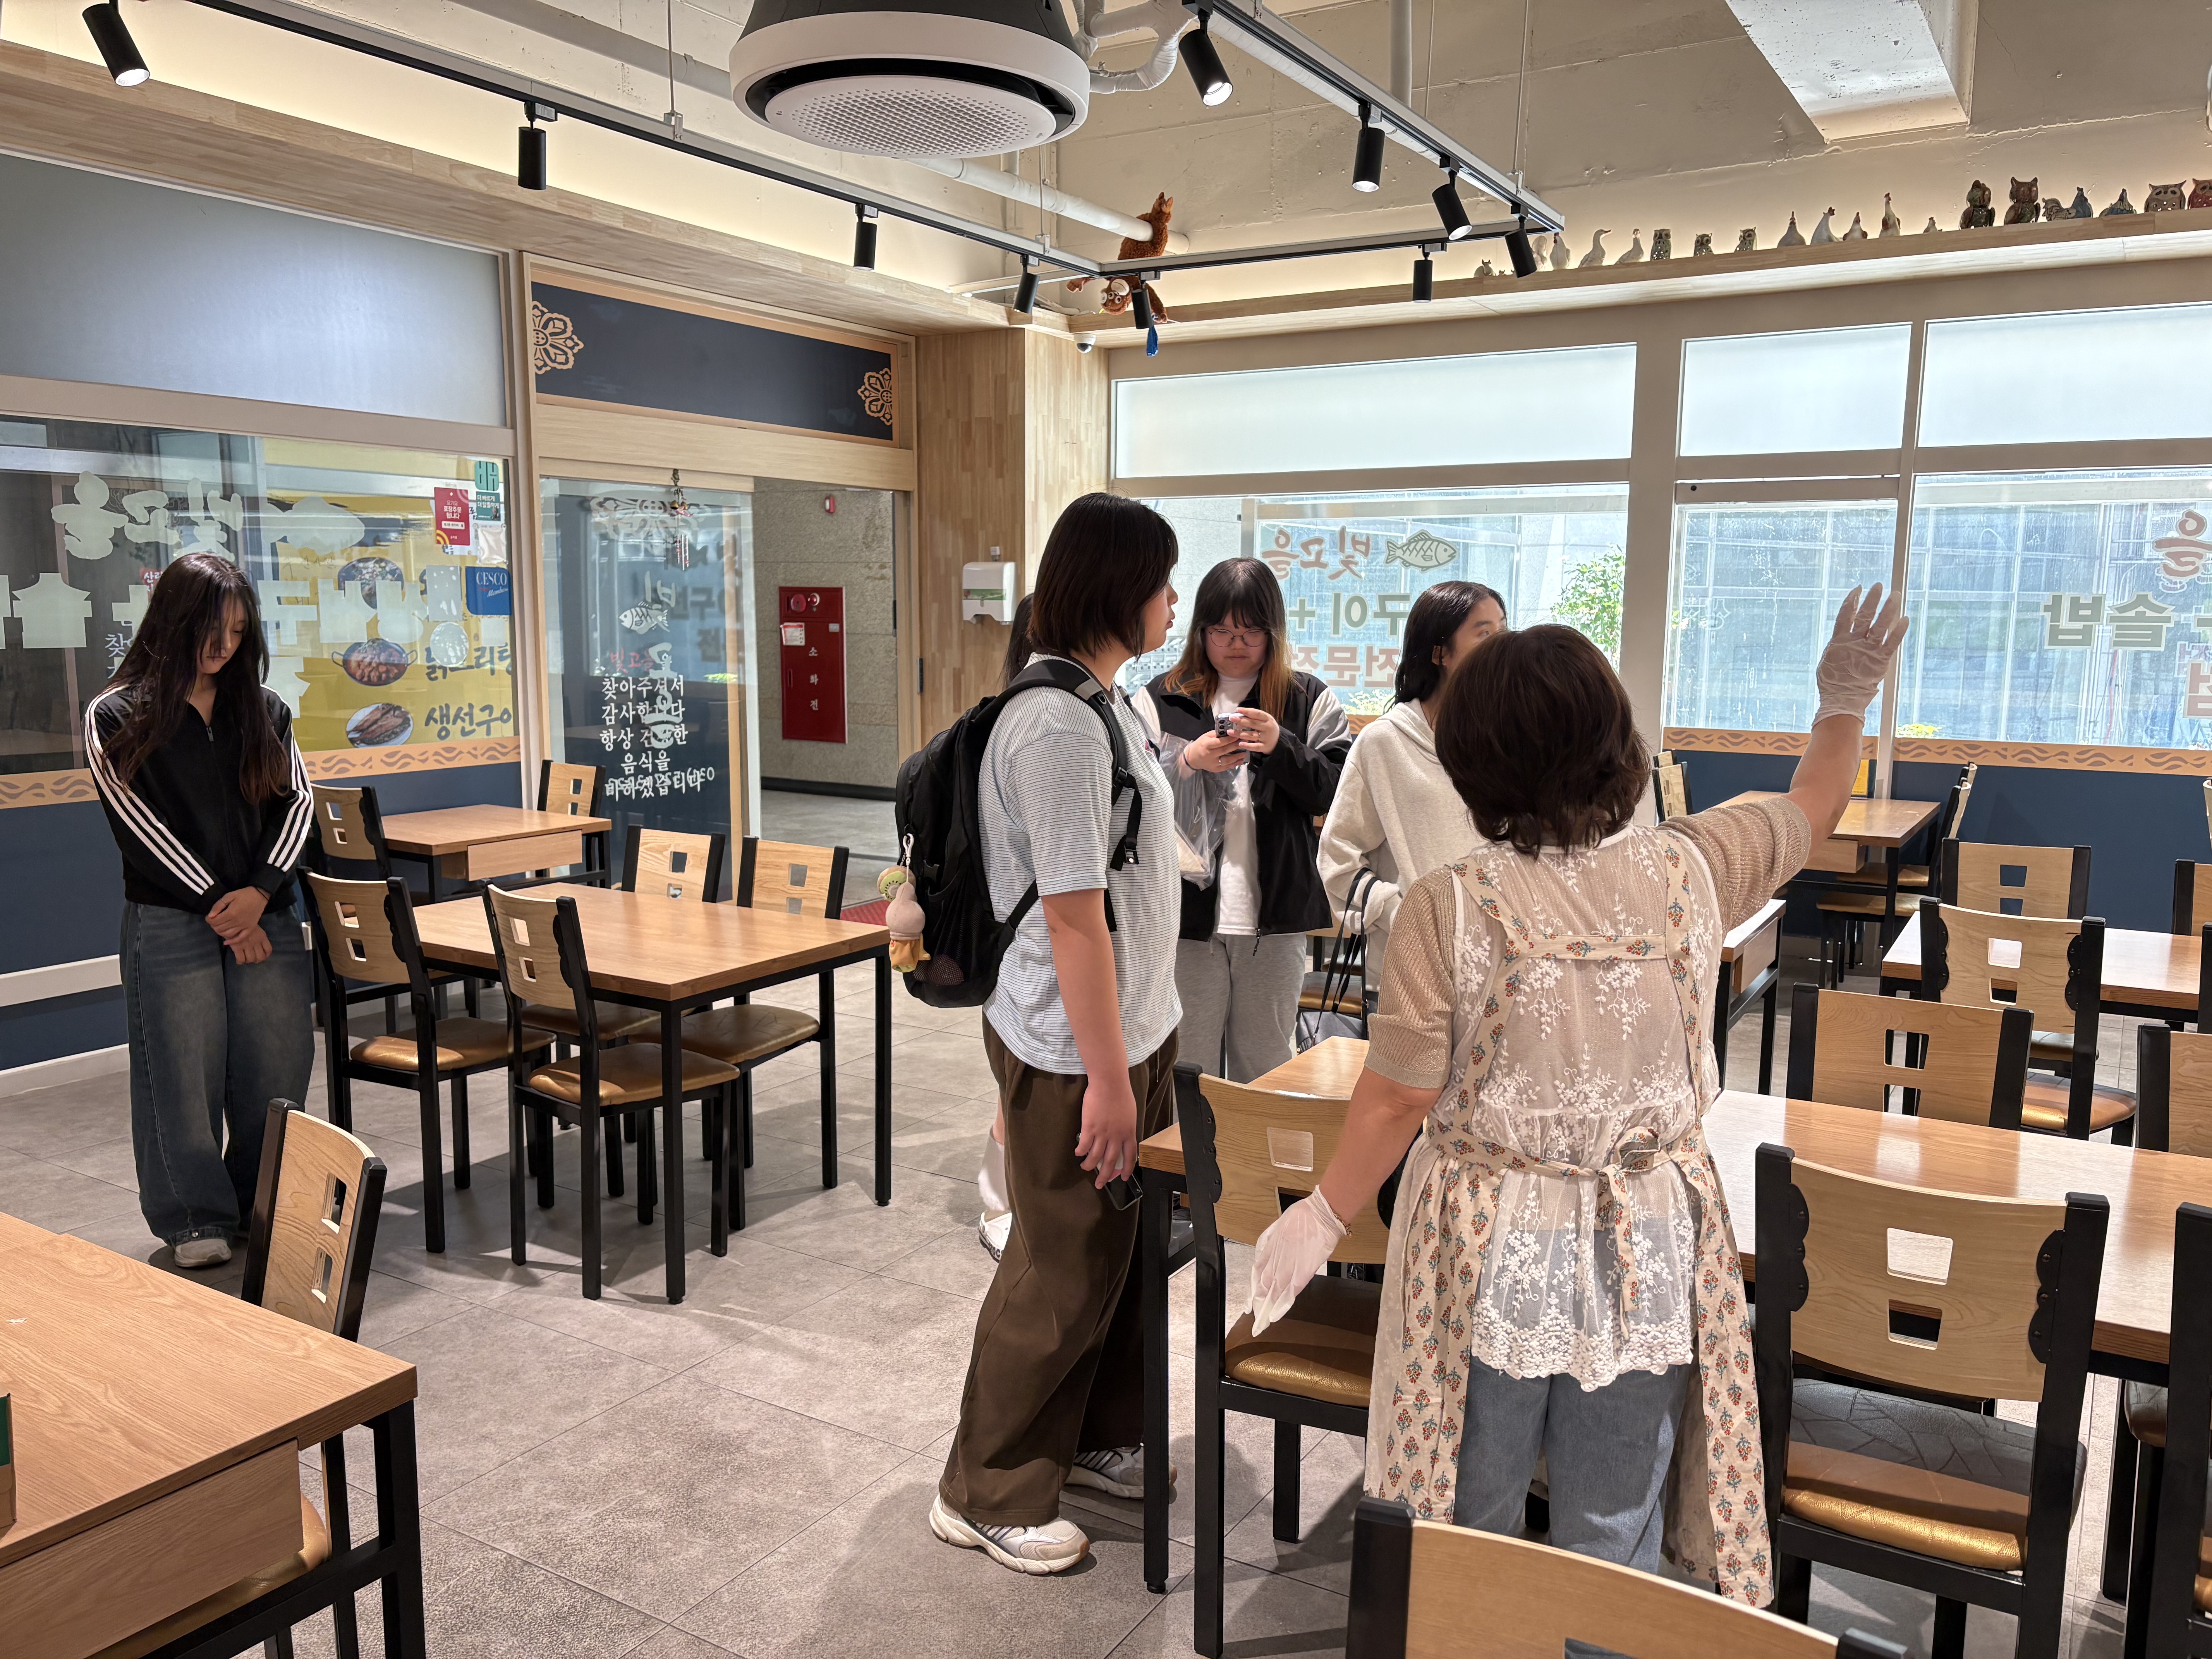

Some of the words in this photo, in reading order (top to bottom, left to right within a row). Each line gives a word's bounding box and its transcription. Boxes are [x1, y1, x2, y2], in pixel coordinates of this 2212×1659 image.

[476, 572, 507, 586] CESCO
[602, 674, 684, 700] 찾아주셔서
[808, 646, 819, 711] 소화전
[599, 727, 634, 752] 항상
[620, 749, 671, 775] 음식을
